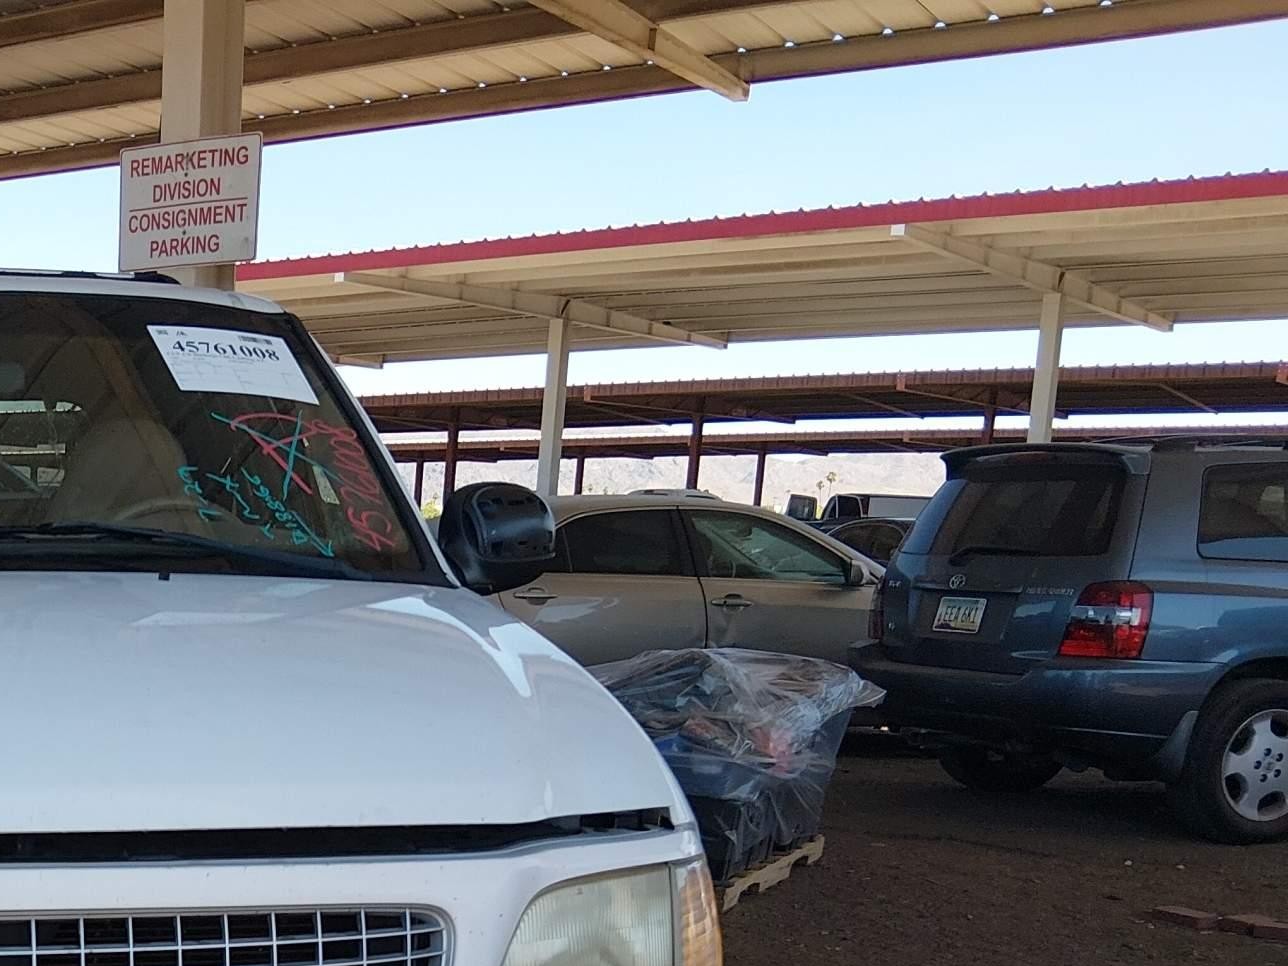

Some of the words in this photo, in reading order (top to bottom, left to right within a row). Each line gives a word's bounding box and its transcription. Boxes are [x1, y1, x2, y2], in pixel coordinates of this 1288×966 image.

[130, 146, 249, 178] REMARKETING
[152, 177, 221, 203] DIVISION
[128, 203, 248, 233] CONSIGNMENT
[149, 234, 220, 259] PARKING
[172, 340, 280, 361] 45761008
